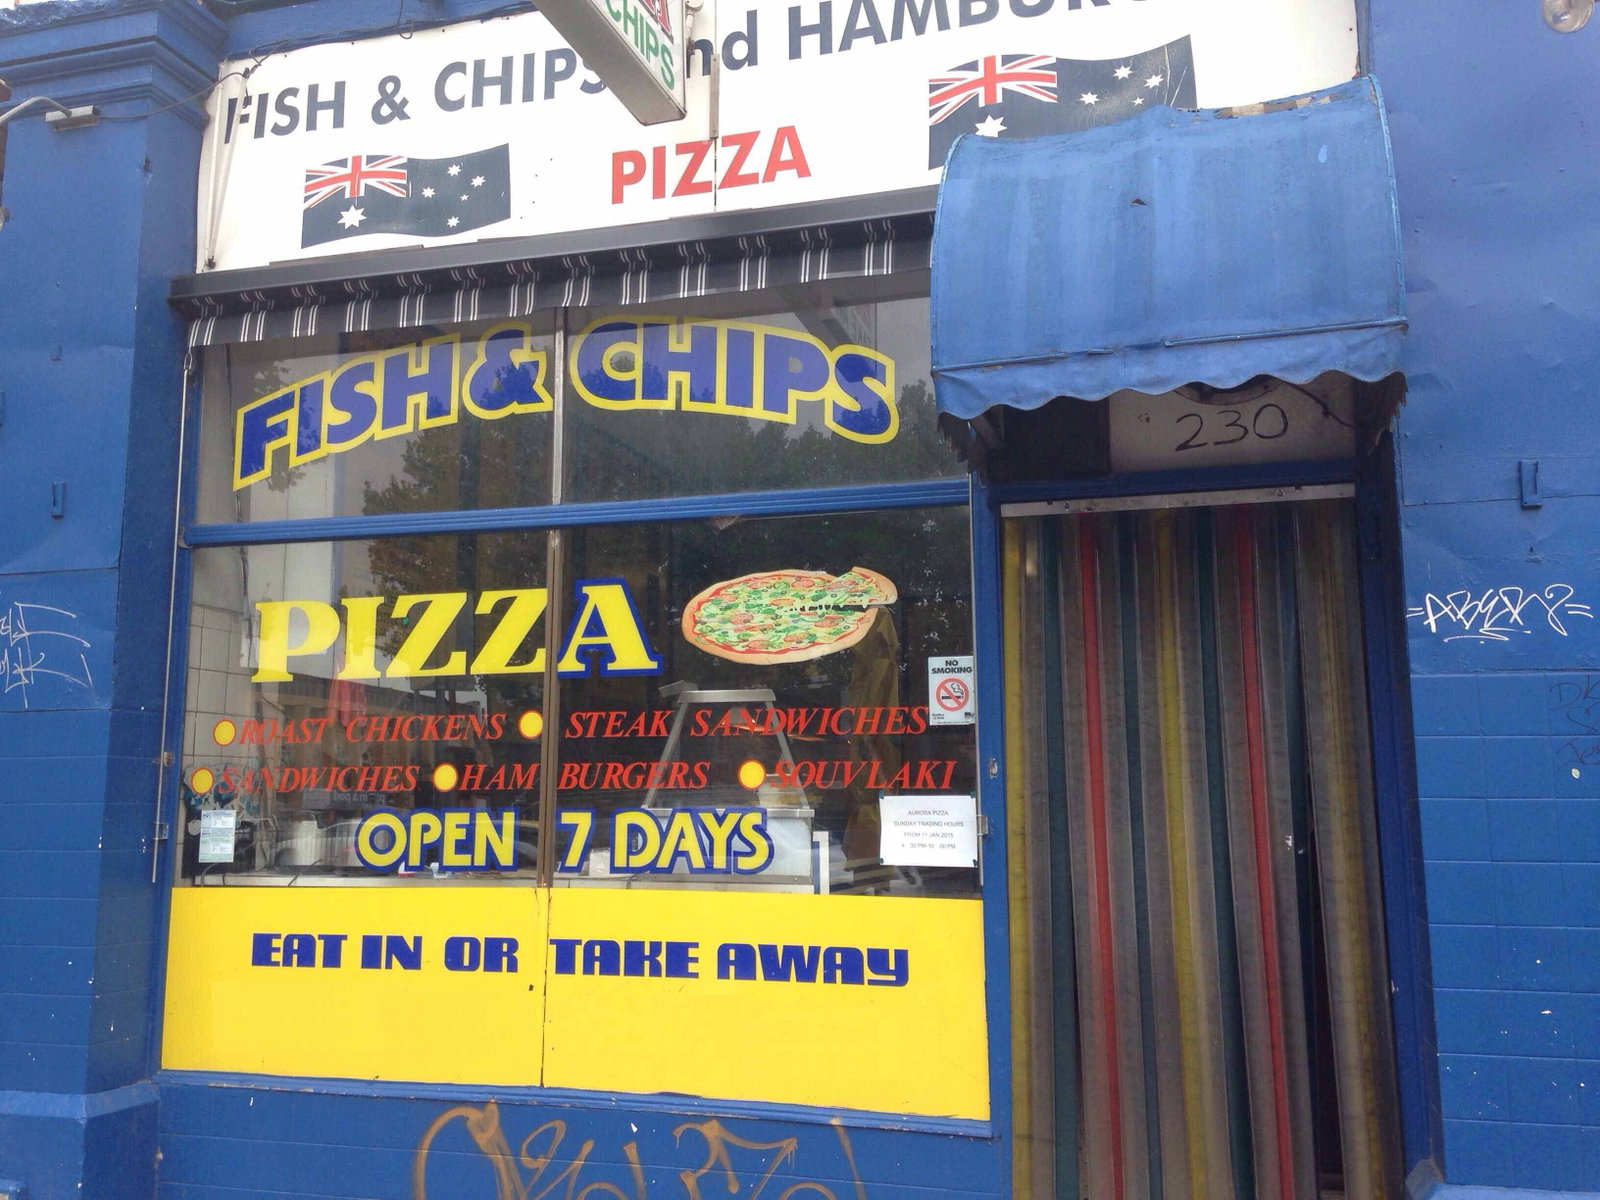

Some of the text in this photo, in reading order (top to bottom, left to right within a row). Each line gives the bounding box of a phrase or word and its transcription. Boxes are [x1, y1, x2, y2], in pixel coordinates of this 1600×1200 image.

[223, 80, 346, 144] FISH
[370, 74, 410, 126] &
[611, 125, 811, 204] PIZZA
[233, 314, 900, 491] FISH & CHIPS
[1175, 403, 1288, 452] 230
[251, 577, 664, 682] PIZZA
[239, 713, 507, 745] ROAST CHICKENS
[565, 705, 930, 739] STEAK SANDWICHES
[217, 760, 957, 793] SANDWICHES HAM BURGERS SOUVLAKI
[354, 807, 775, 875] OPEN 7 DAYS
[251, 933, 909, 987] EAT IN OR TAKE AWAY
